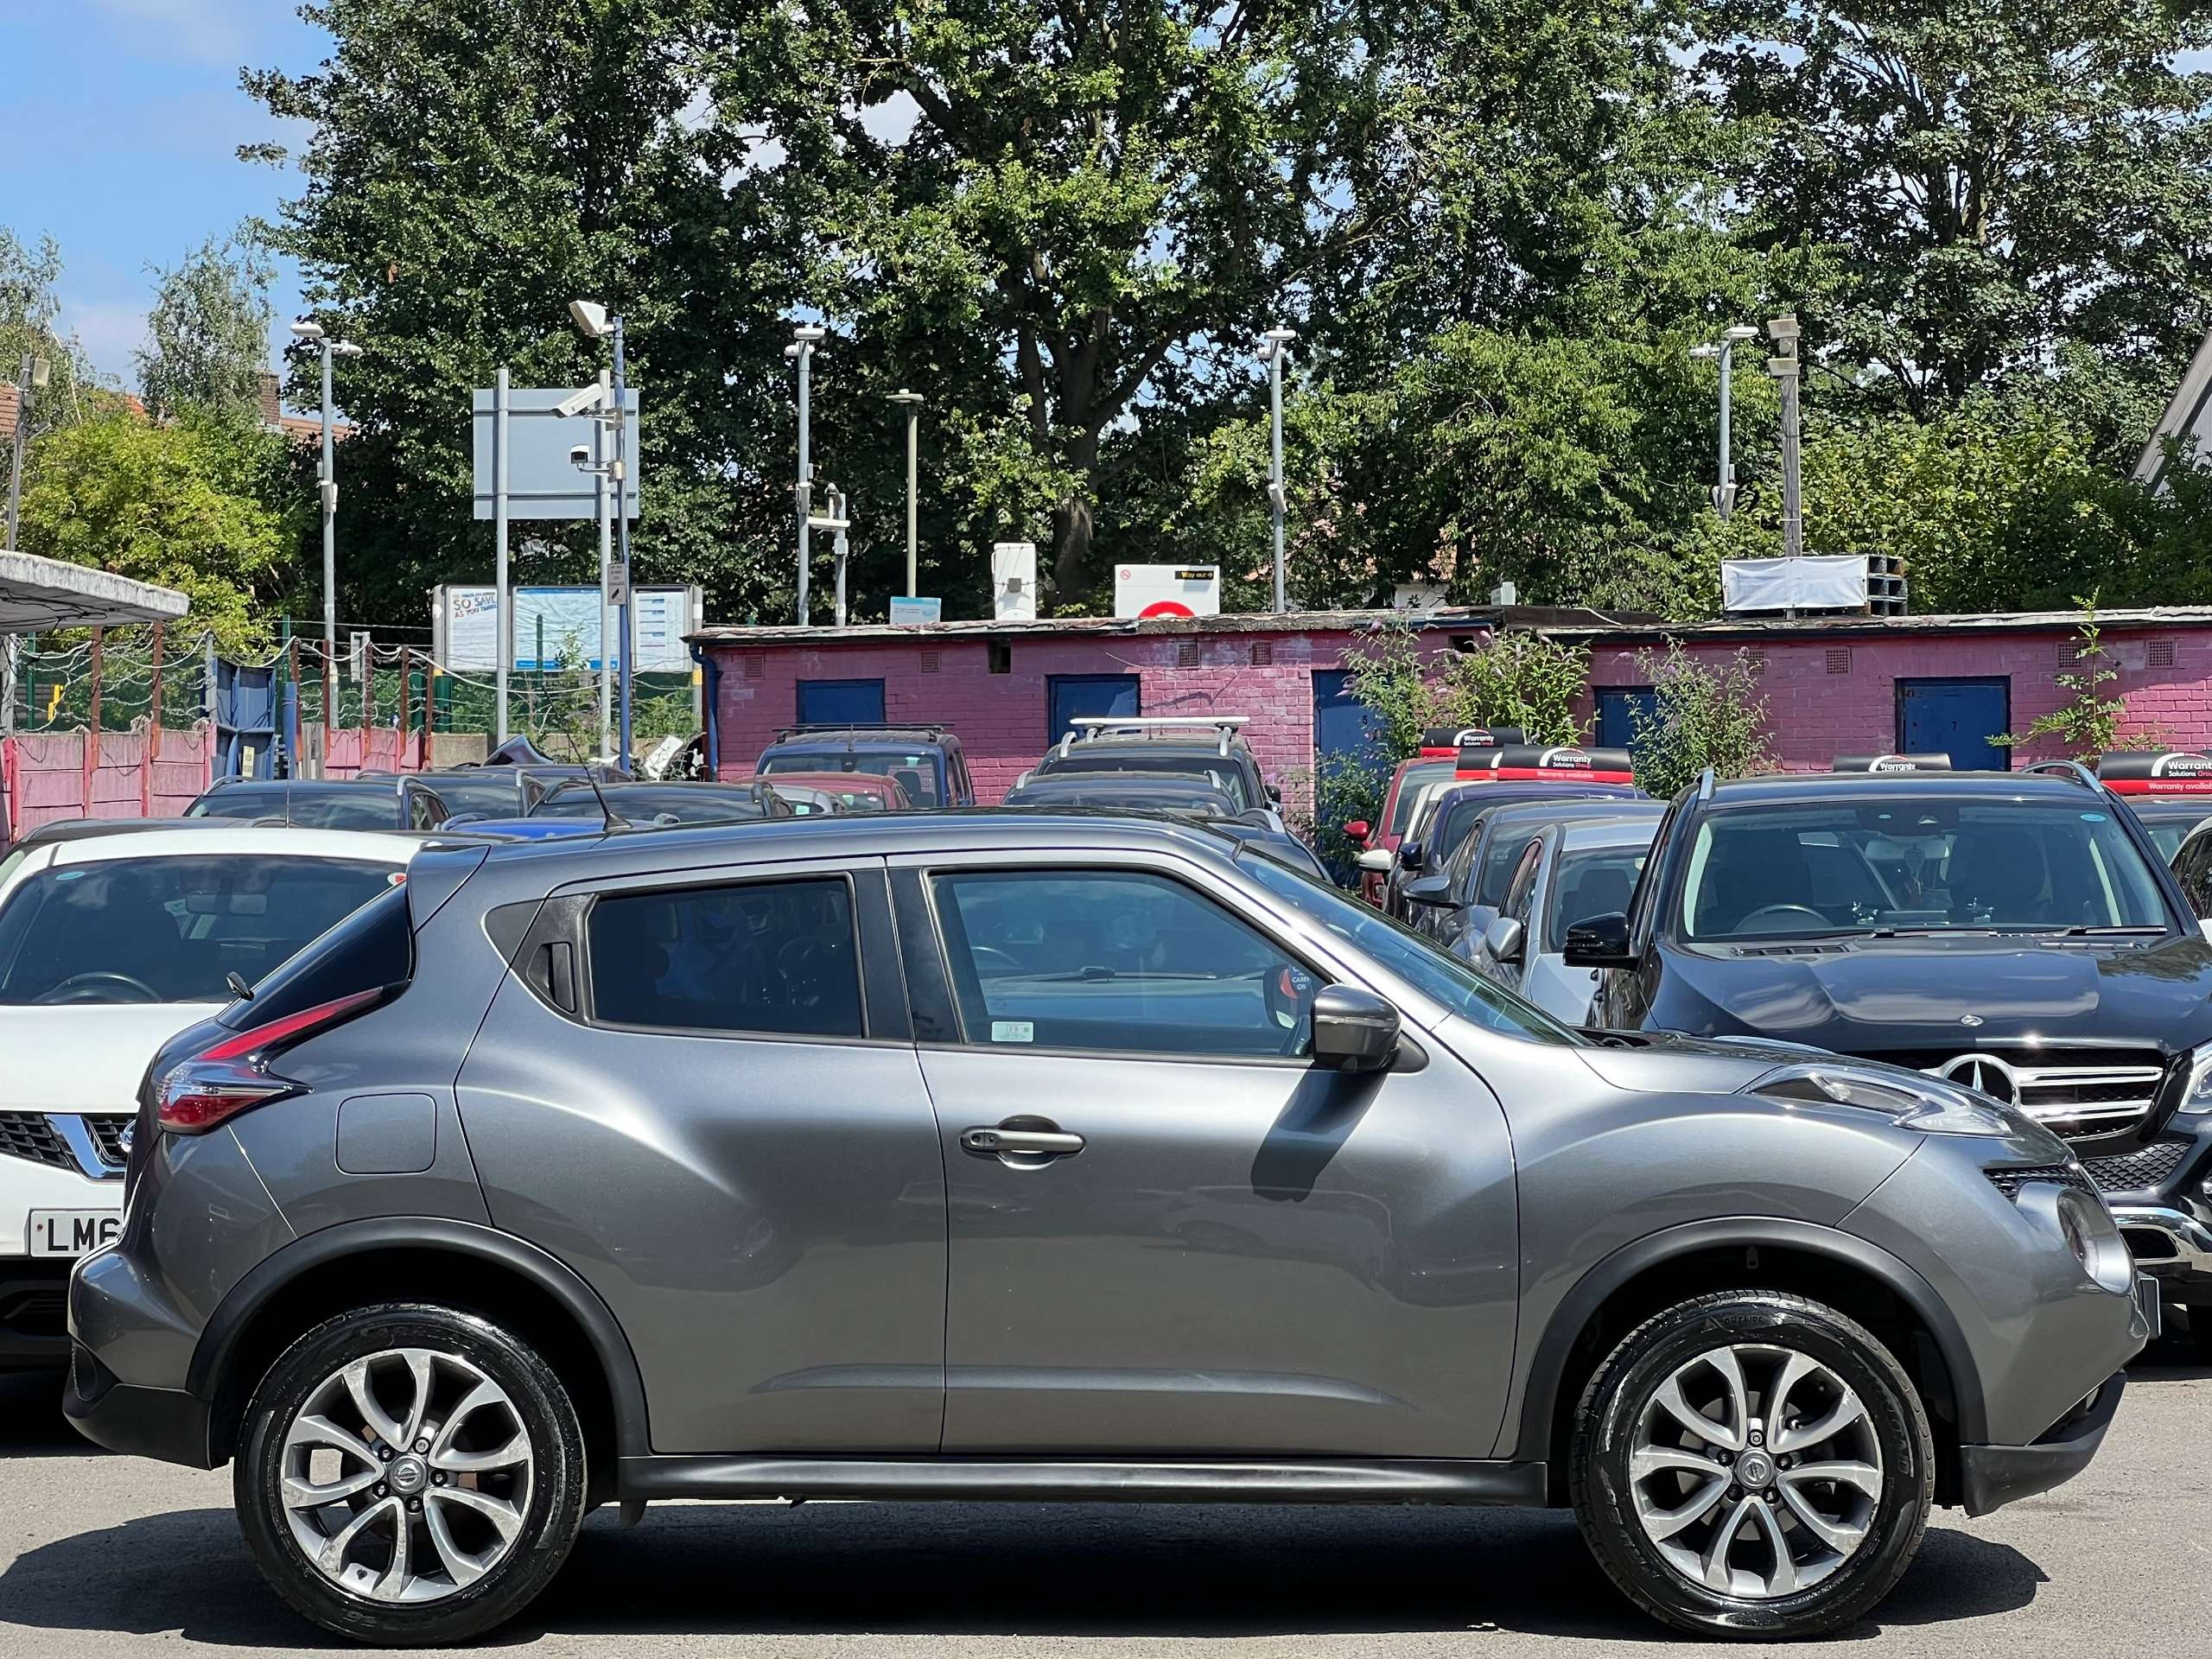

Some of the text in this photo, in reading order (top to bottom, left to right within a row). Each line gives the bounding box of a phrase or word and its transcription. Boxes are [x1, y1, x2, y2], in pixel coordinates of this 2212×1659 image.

[454, 599, 471, 610] SO
[1553, 753, 1592, 765] Warranty
[1879, 762, 1916, 771] Warranty
[2167, 760, 2212, 770] Warrant
[2148, 782, 2184, 791] Warranty
